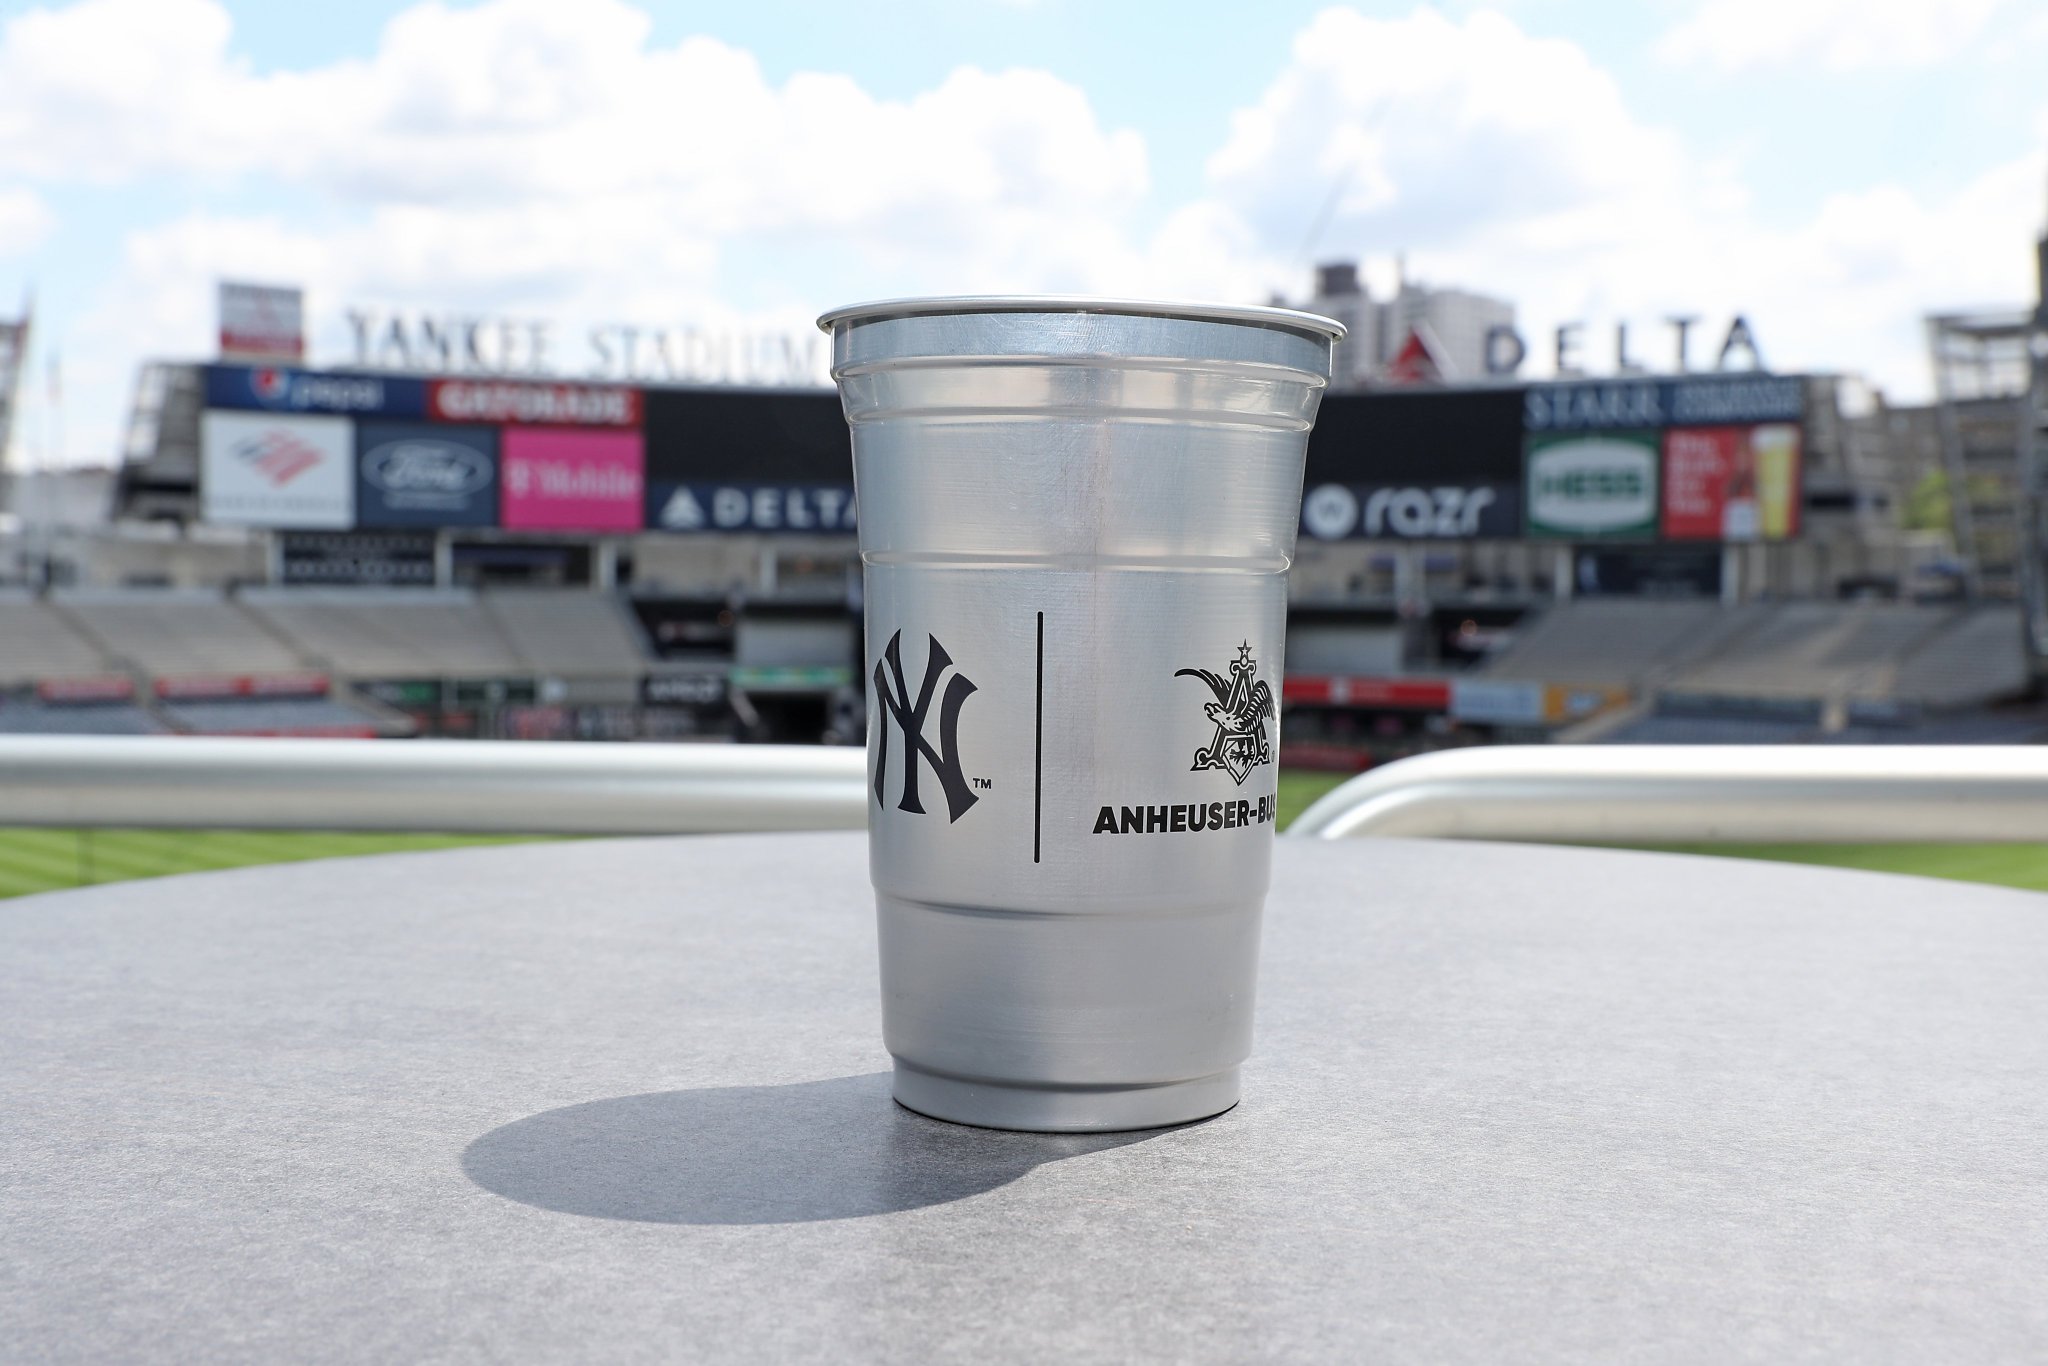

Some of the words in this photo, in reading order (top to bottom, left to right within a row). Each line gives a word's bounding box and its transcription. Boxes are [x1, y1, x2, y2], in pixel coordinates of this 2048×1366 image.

[346, 304, 556, 372] YANKEE
[589, 325, 826, 386] STADIUM
[1485, 314, 1765, 374] DELTA
[437, 382, 634, 423] GATORADE
[1524, 384, 1663, 430] STARR
[1543, 470, 1643, 496] HESS
[1365, 487, 1495, 536] razr
[972, 777, 992, 789] TM
